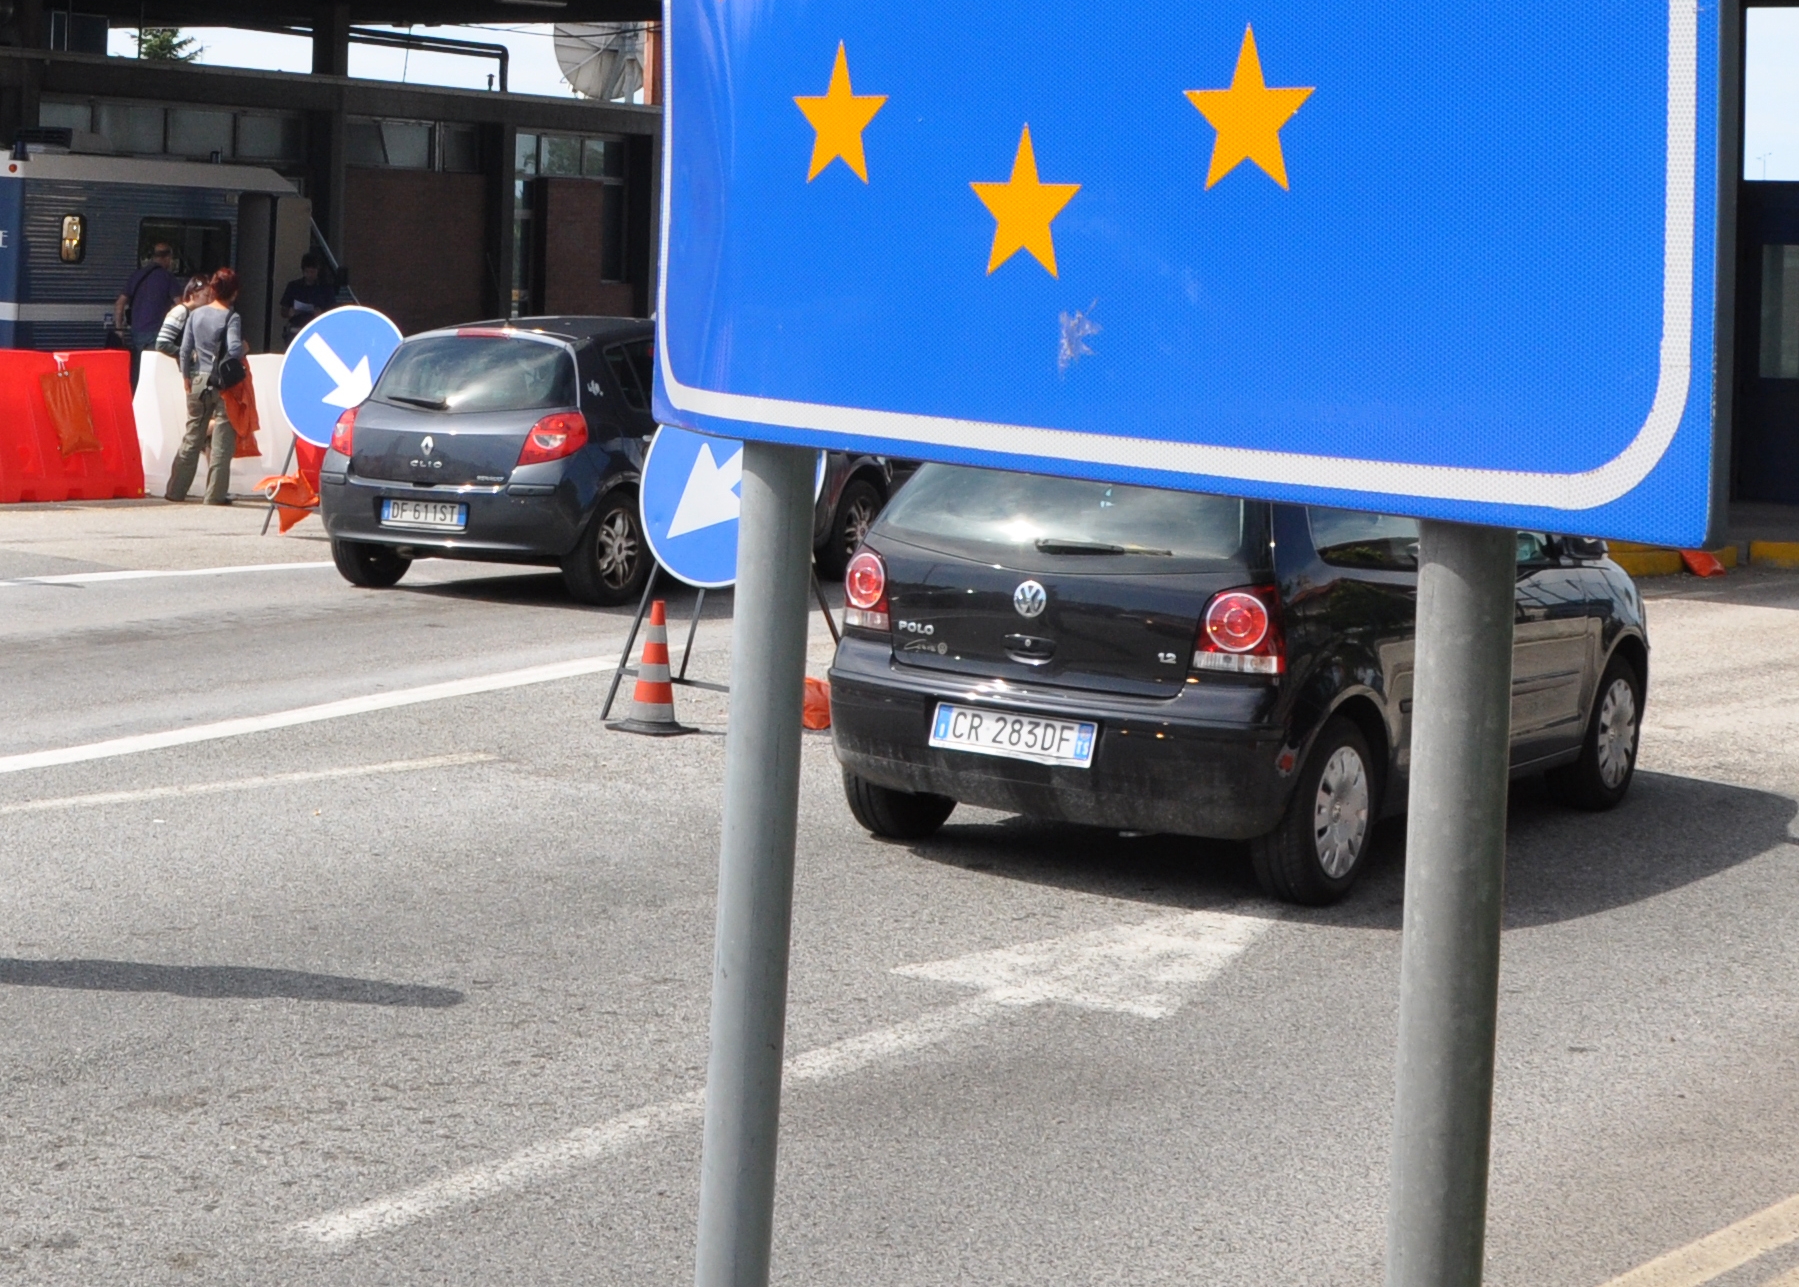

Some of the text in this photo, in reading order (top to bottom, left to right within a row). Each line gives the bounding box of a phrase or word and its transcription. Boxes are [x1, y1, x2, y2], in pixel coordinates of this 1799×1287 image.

[410, 459, 443, 469] CLIO
[391, 501, 457, 523] DF 611ST
[898, 620, 935, 635] POLO
[952, 711, 1075, 753] CR 283DF
